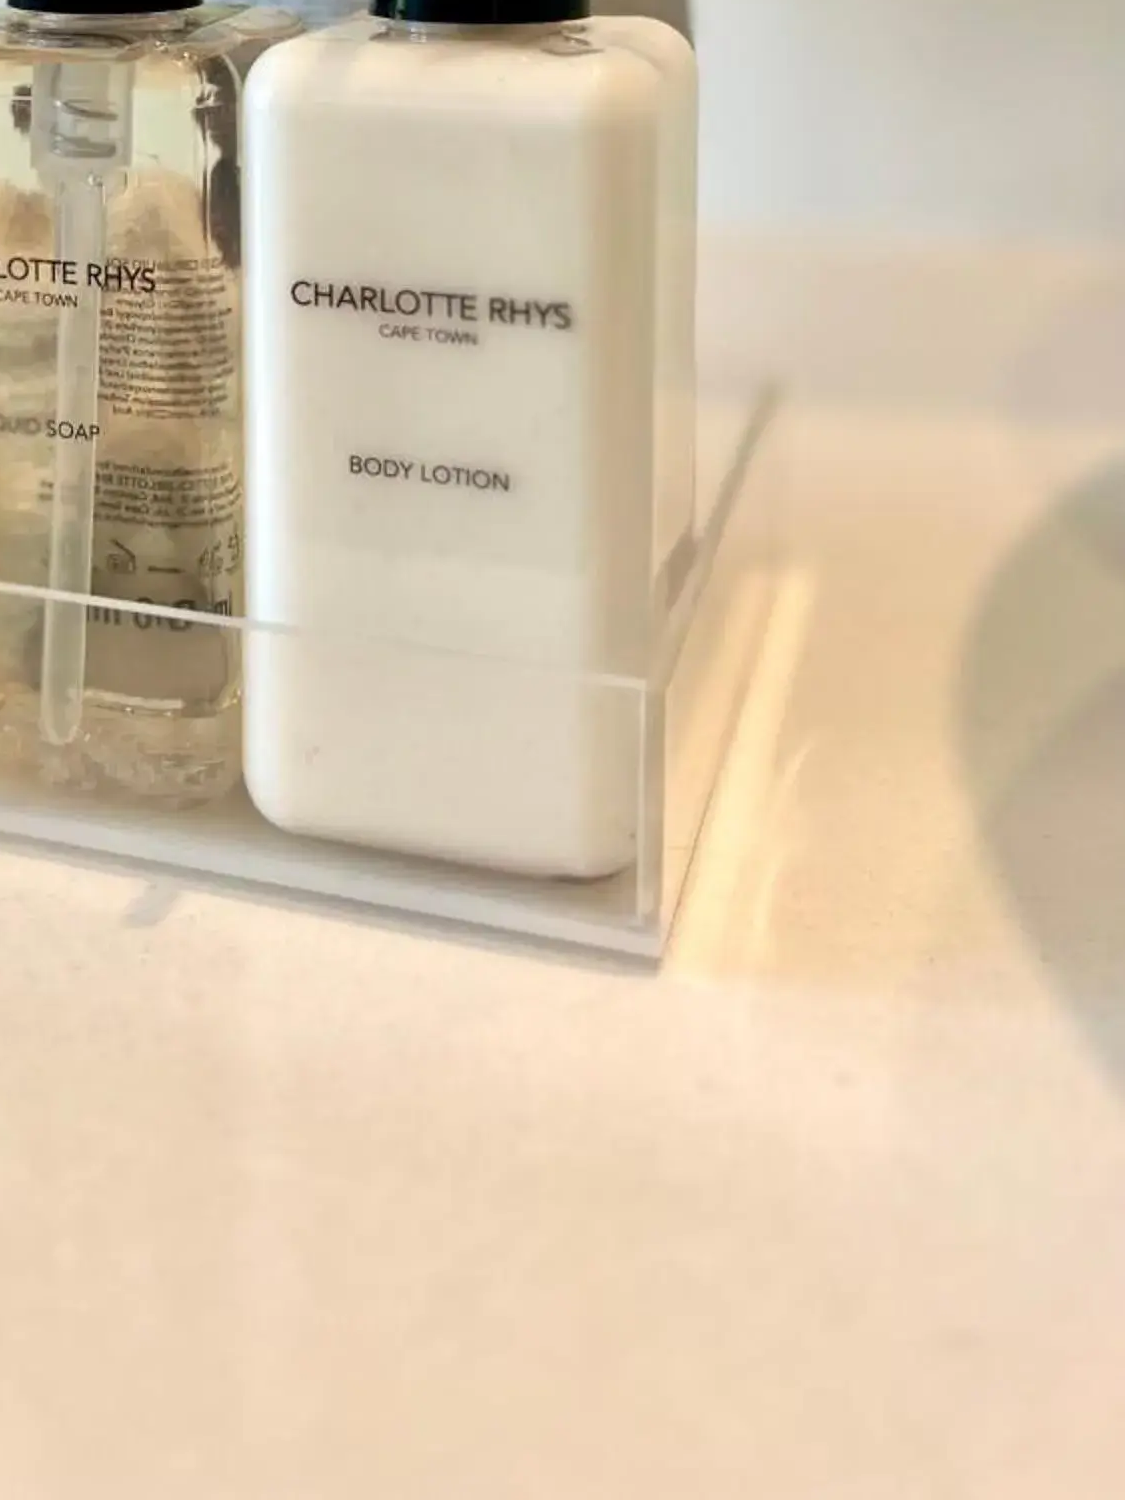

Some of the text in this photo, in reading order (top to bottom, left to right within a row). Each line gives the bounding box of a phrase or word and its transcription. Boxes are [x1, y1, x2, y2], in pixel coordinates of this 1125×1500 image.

[87, 264, 156, 293] RHYS
[34, 291, 78, 309] TOWN
[291, 281, 572, 330] CHARLOTTE RHYS
[378, 324, 479, 346] CAPE TOWN
[46, 419, 100, 442] SOAP
[349, 455, 510, 492] BODY LOTION
